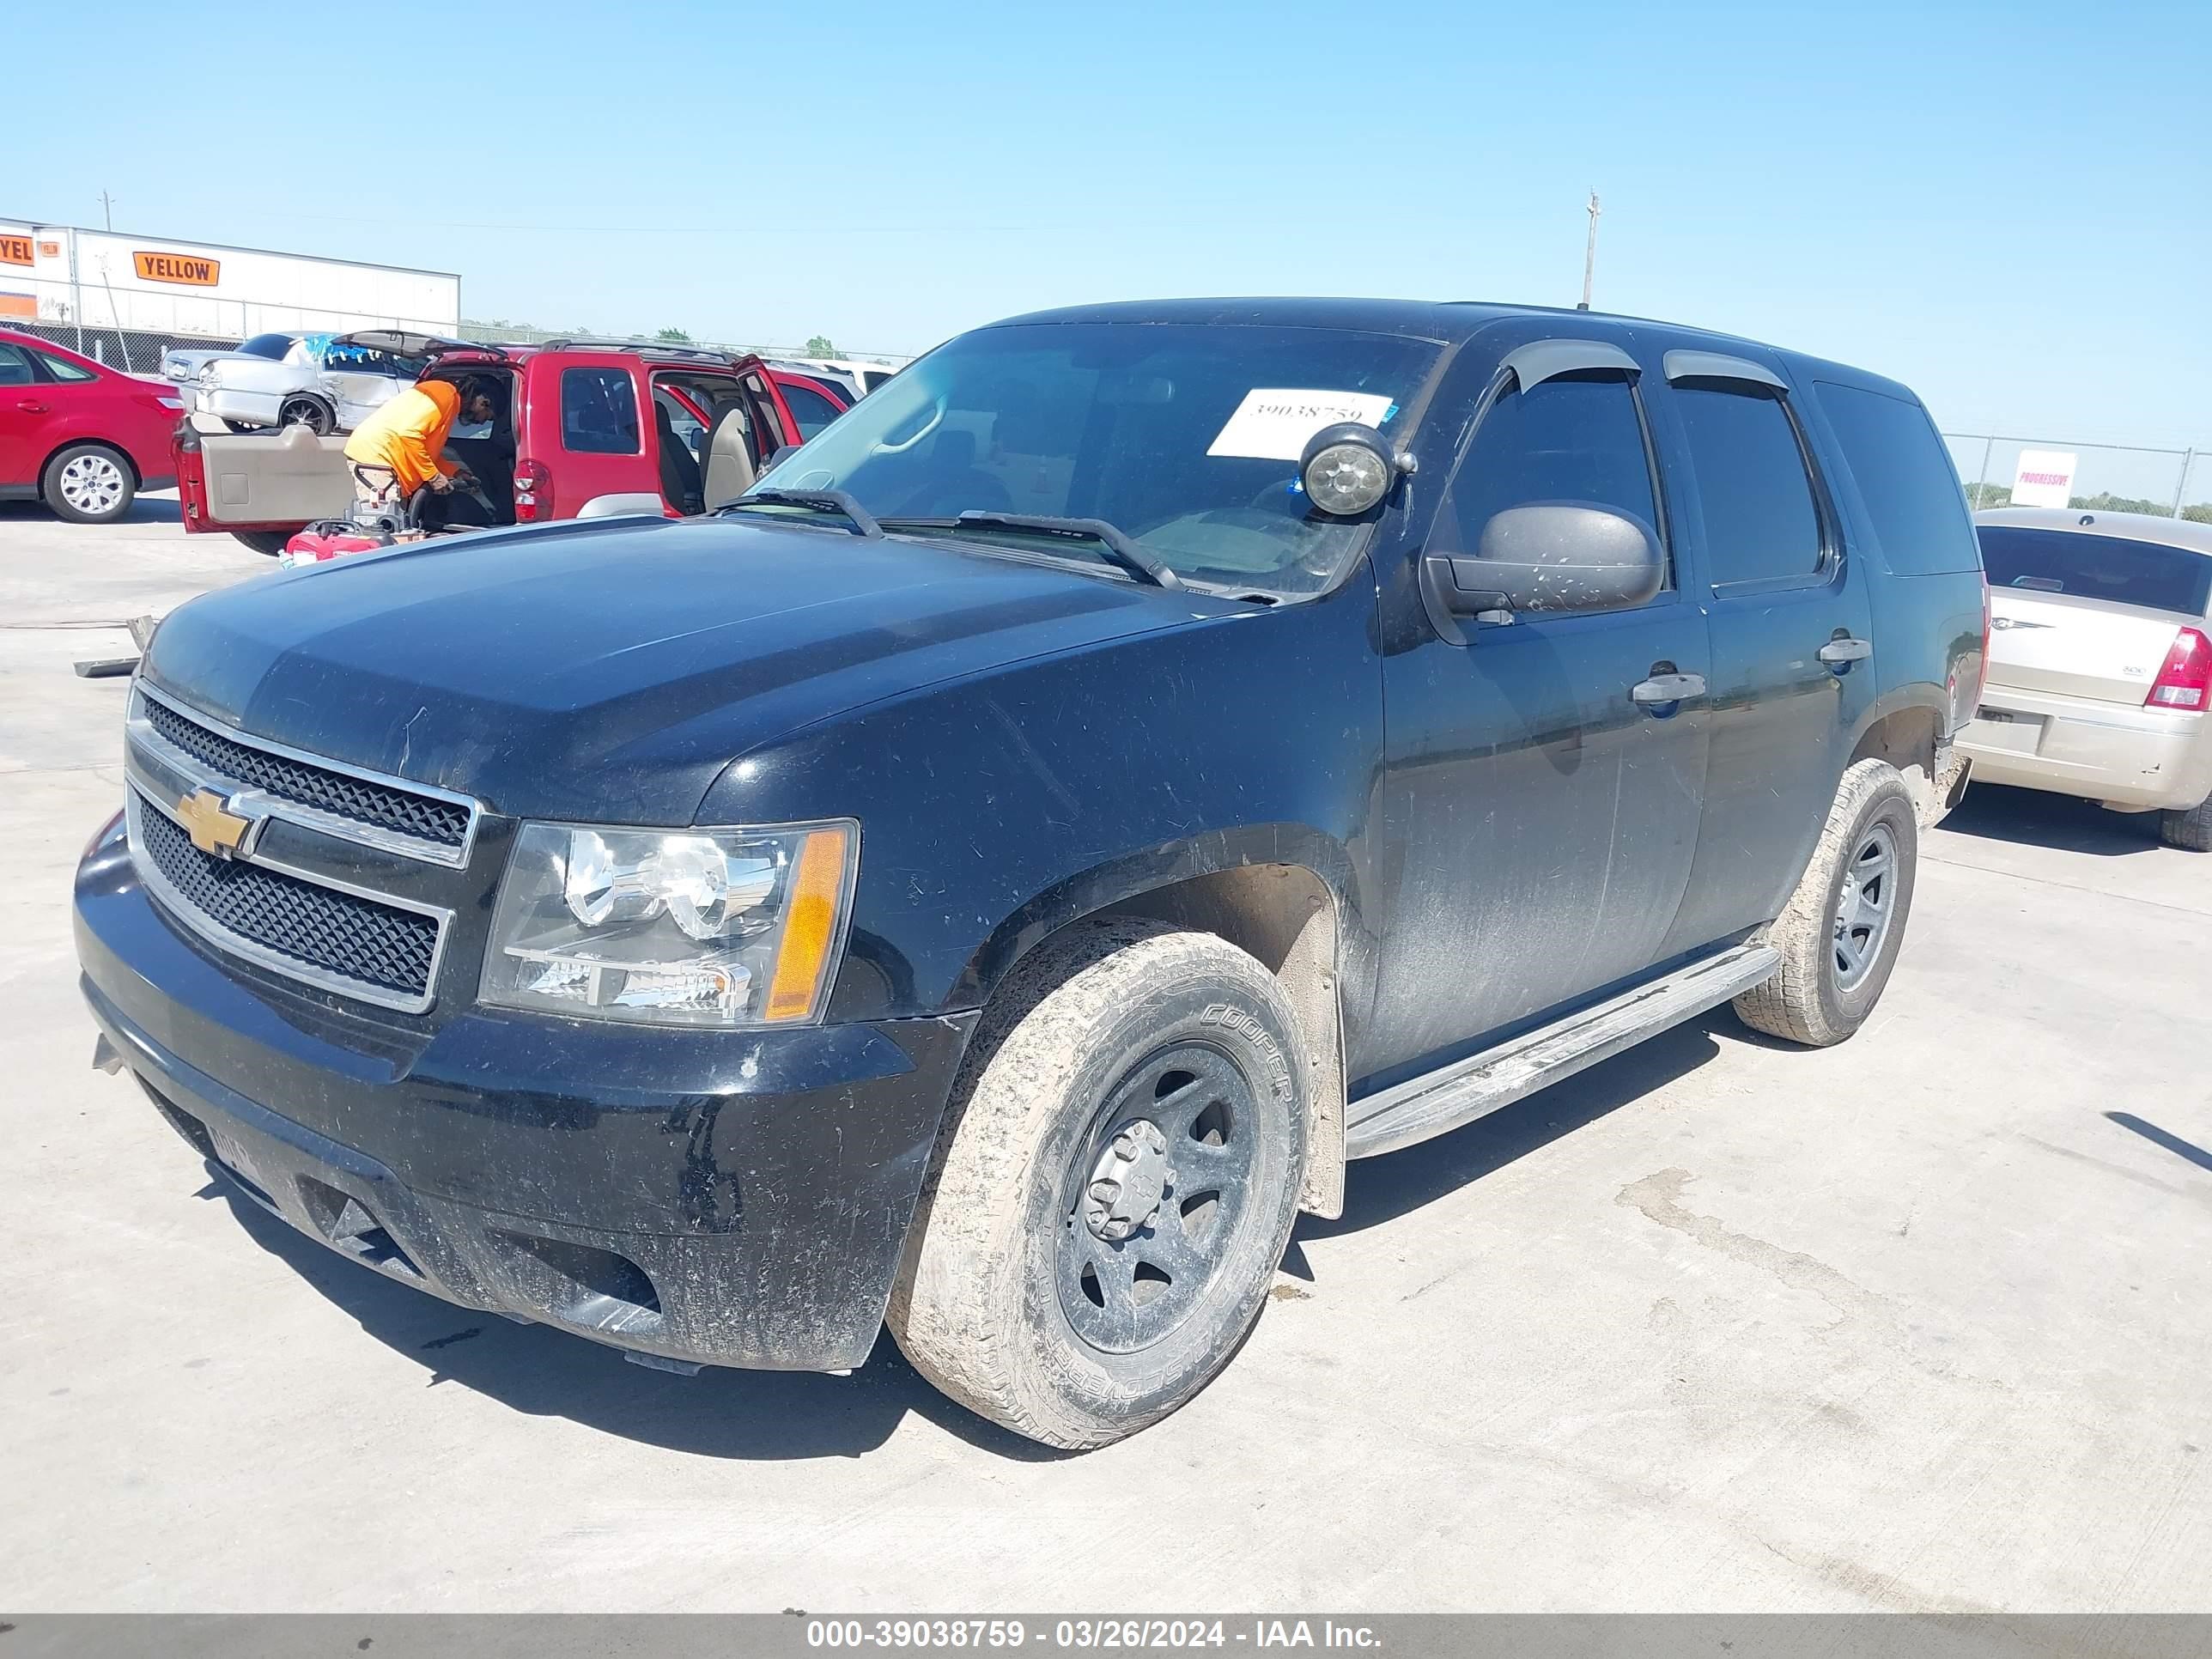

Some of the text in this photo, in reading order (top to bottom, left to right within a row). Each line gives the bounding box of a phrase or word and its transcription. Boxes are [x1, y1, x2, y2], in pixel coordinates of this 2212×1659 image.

[144, 257, 210, 281] YELLOW
[1250, 404, 1363, 422] 39038759
[2019, 471, 2069, 487] PROGRESSIVE
[1200, 1003, 1293, 1104] COOPER
